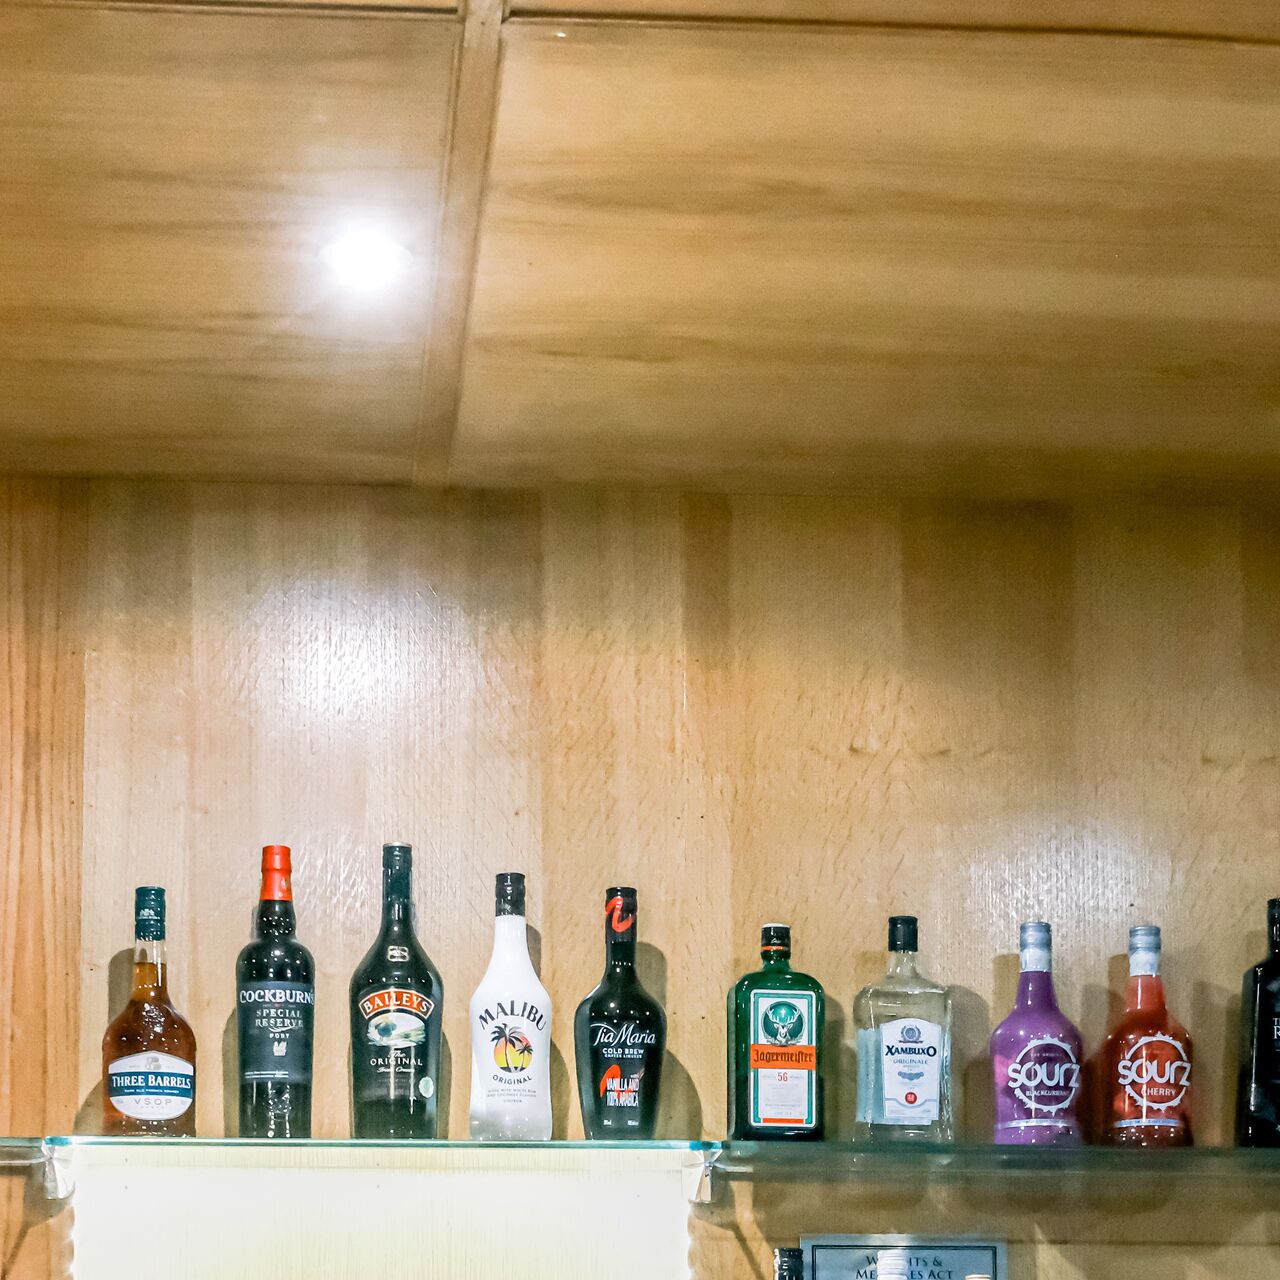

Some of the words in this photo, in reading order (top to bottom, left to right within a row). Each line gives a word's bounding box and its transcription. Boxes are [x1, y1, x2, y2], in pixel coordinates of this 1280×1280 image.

[363, 993, 429, 1013] BAILEYS
[256, 1009, 302, 1017] SPECIAL
[479, 1000, 546, 1031] MALIBU
[590, 1023, 617, 1046] Tia
[610, 1024, 656, 1046] Maria
[885, 1045, 936, 1056] XAMBUXO
[112, 1076, 145, 1087] THREE
[148, 1075, 190, 1088] BARRELS
[493, 1075, 532, 1085] ORIGINAL
[778, 1072, 788, 1081] 56
[1141, 1087, 1176, 1096] CHERRY
[933, 1256, 943, 1265] &
[928, 1270, 953, 1279] ACT
